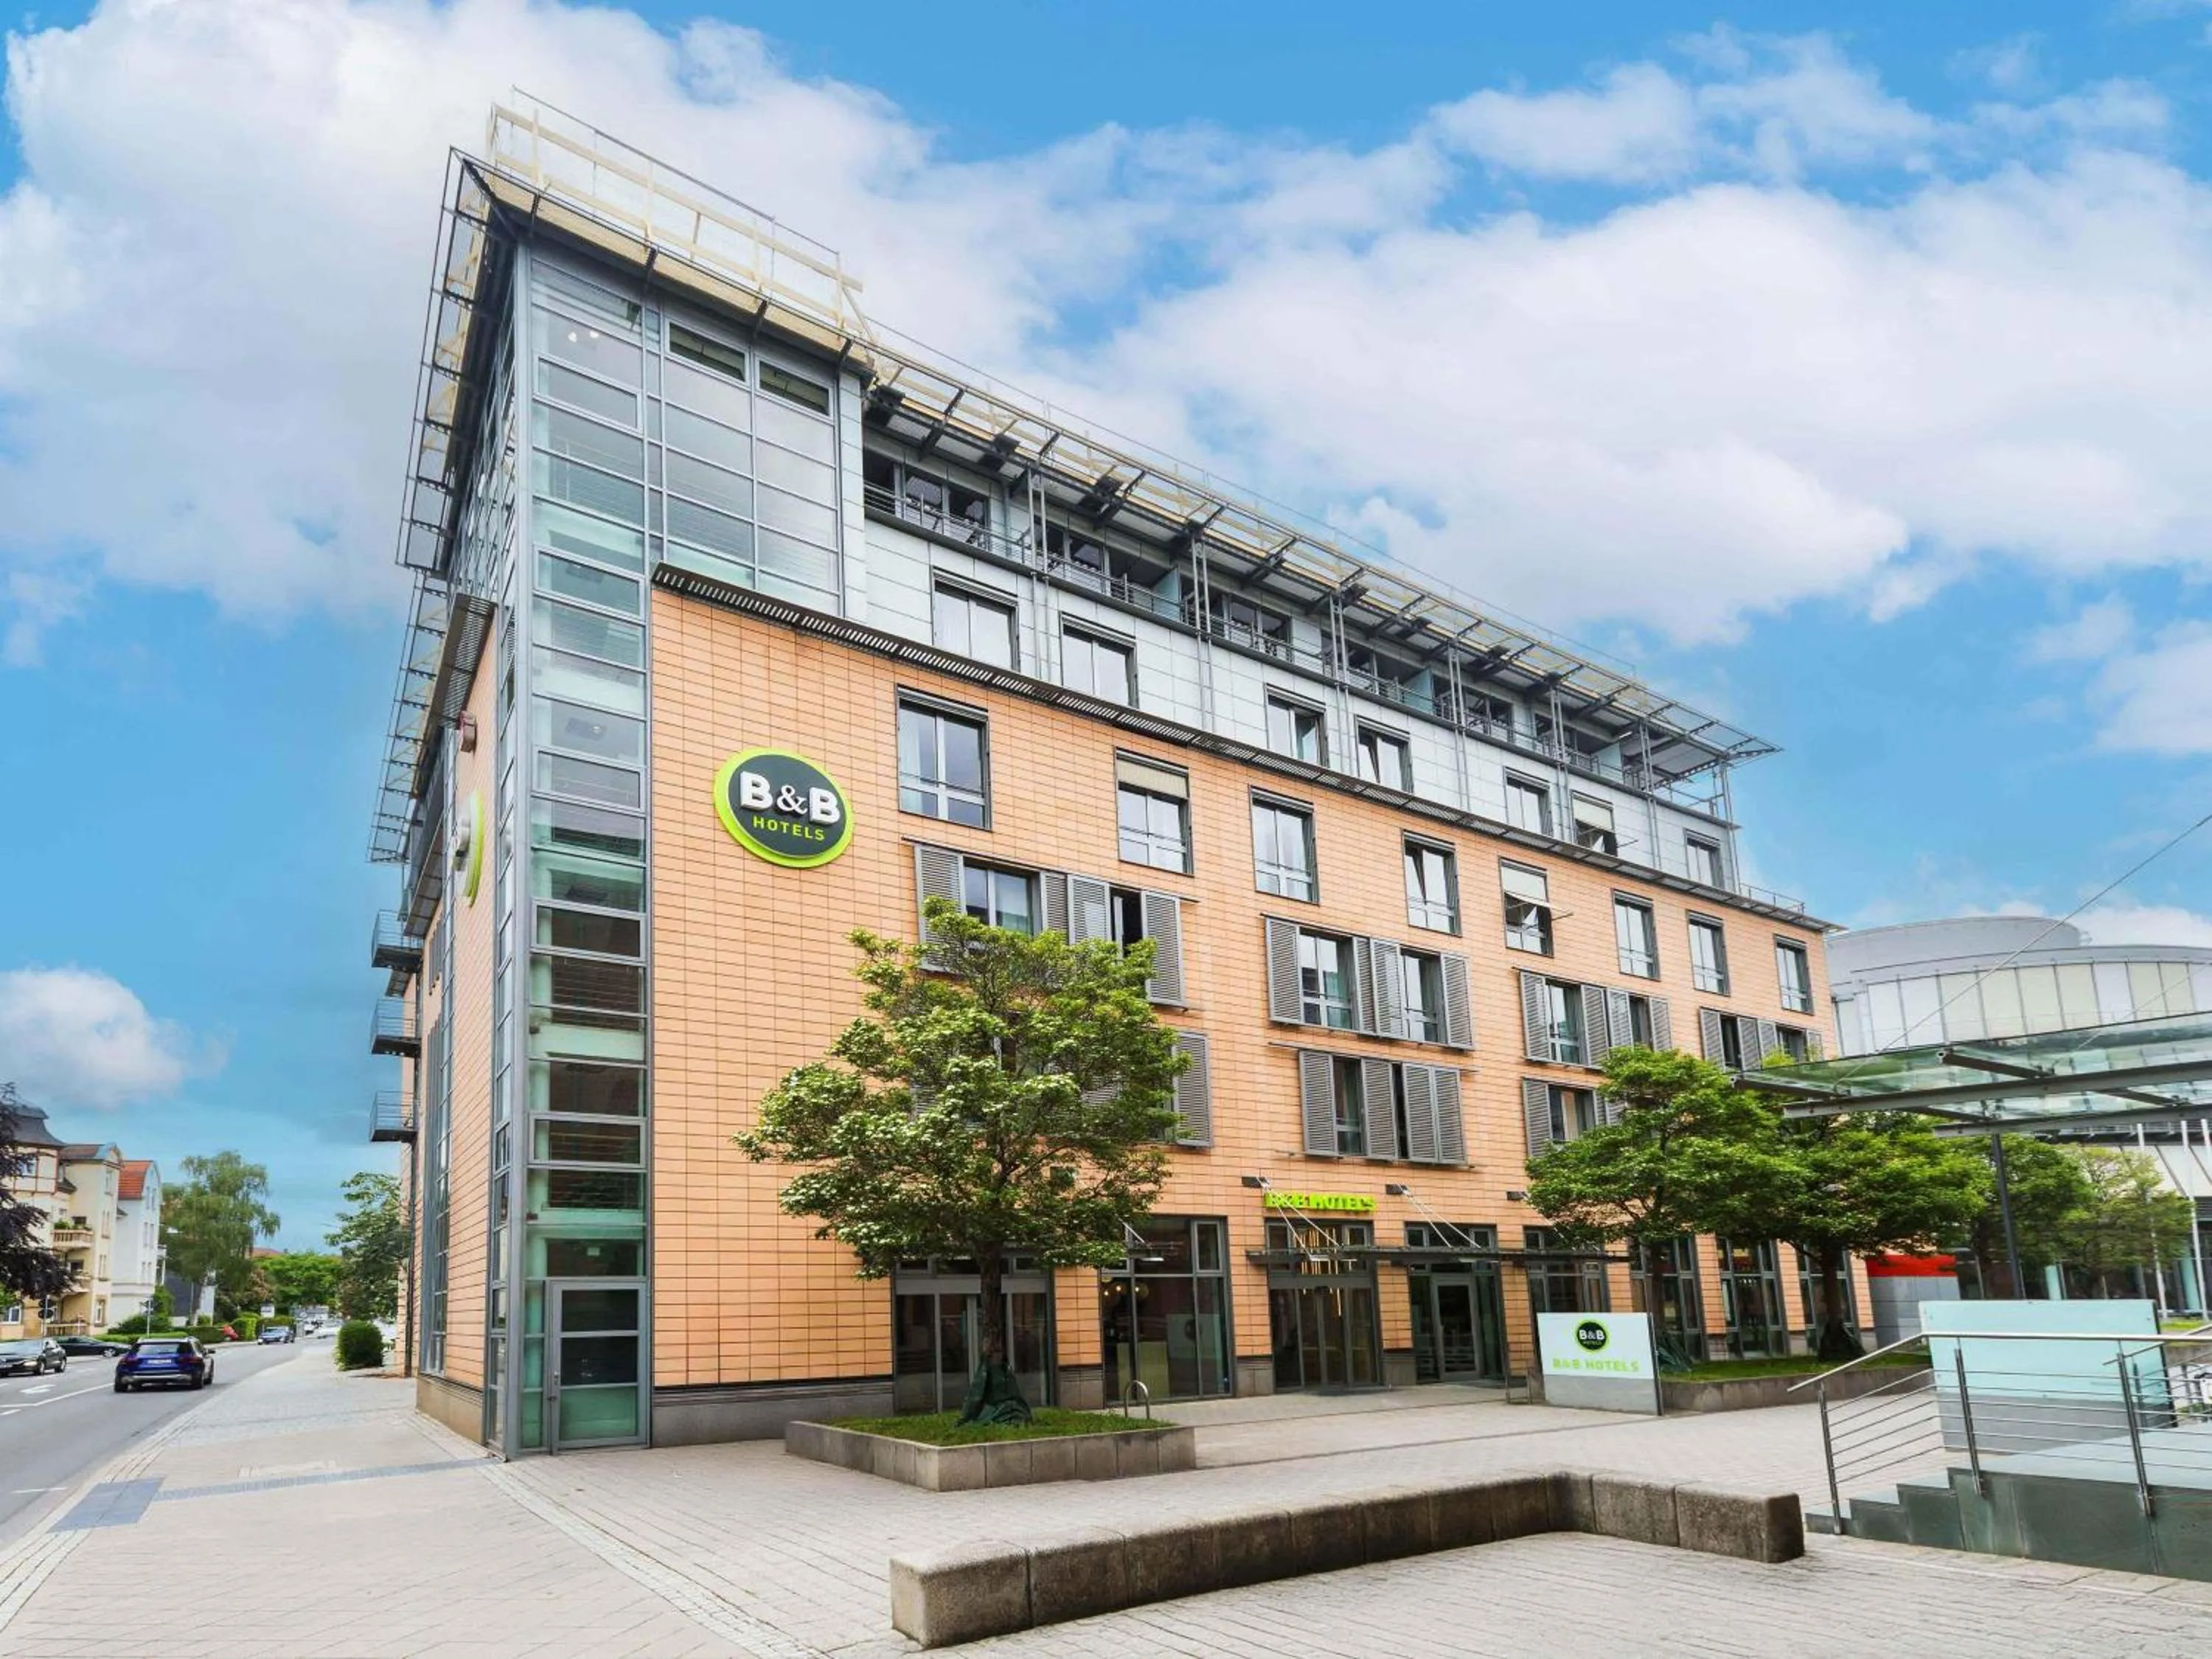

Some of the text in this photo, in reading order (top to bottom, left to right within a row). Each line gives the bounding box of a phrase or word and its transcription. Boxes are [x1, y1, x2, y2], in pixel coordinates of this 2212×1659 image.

[740, 771, 841, 825] B&B
[752, 815, 825, 841] HOTELS
[1579, 1329, 1605, 1340] B&B
[1586, 1360, 1639, 1372] HOTELS
